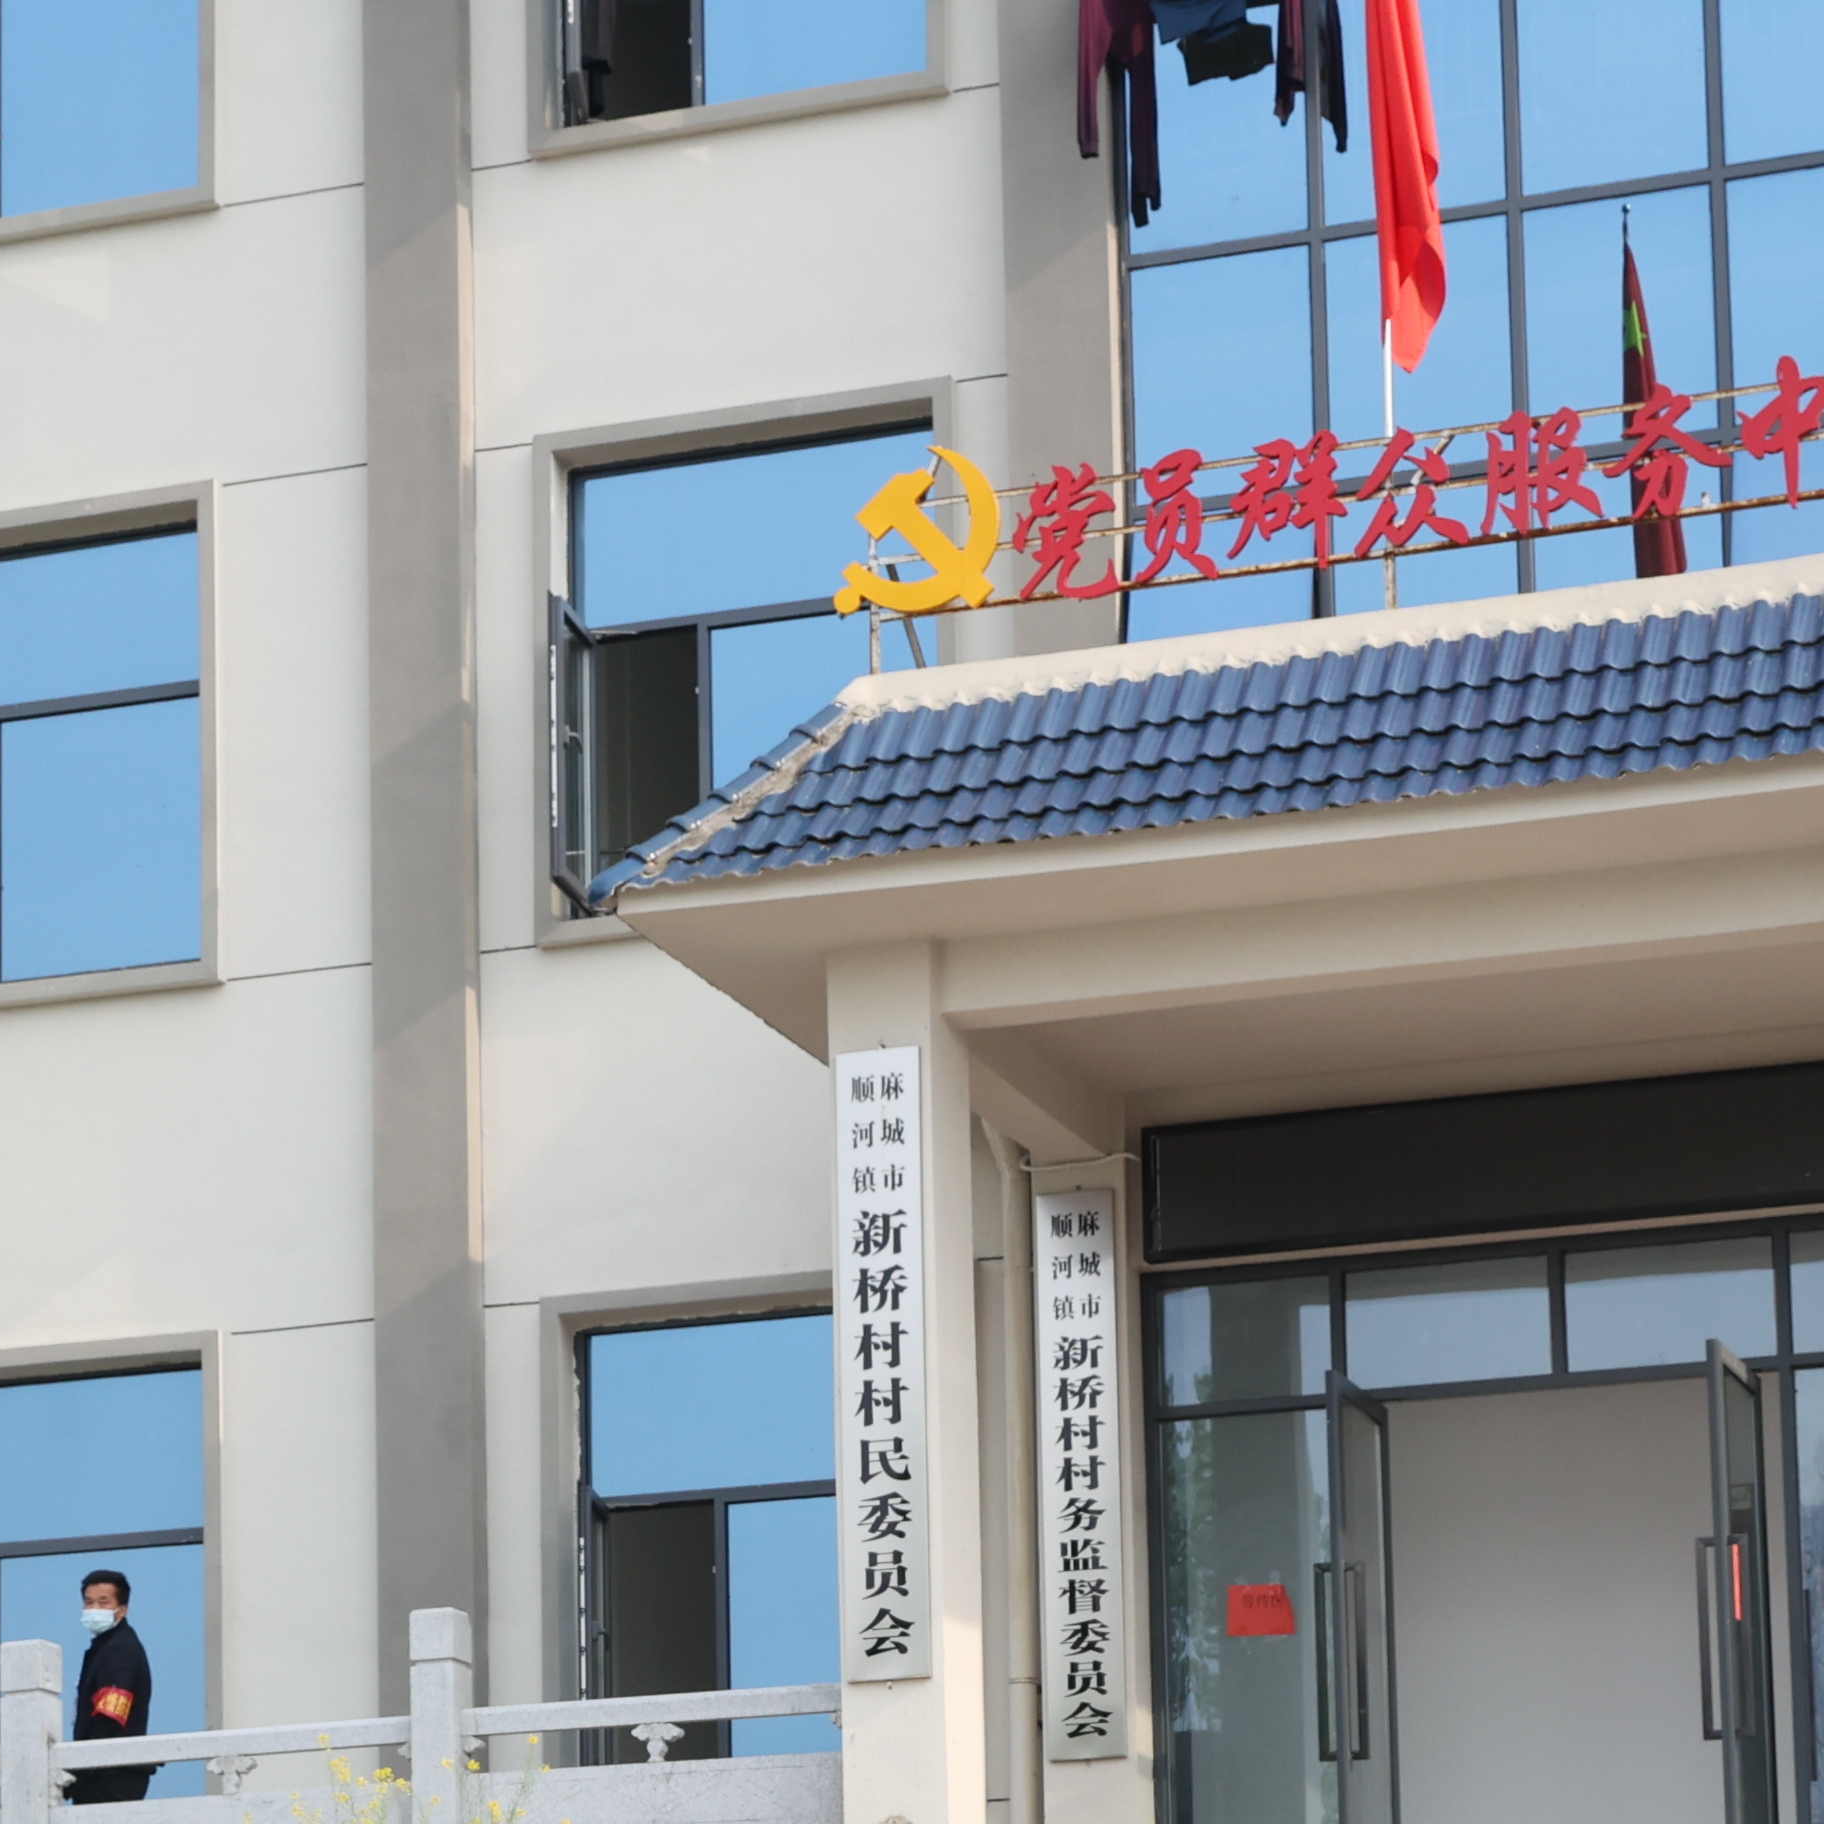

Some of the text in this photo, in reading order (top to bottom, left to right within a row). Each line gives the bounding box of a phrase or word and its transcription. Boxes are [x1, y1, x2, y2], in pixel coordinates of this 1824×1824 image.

[850, 1075, 876, 1194] 顺河镇
[880, 1071, 906, 1193] 麻城市
[1050, 1212, 1075, 1322] 顺河镇
[1077, 1210, 1101, 1321] 麻城市
[852, 1209, 915, 1658] 新桥村村民委员会
[1052, 1335, 1114, 1739] 新桥村村务监督委员会
